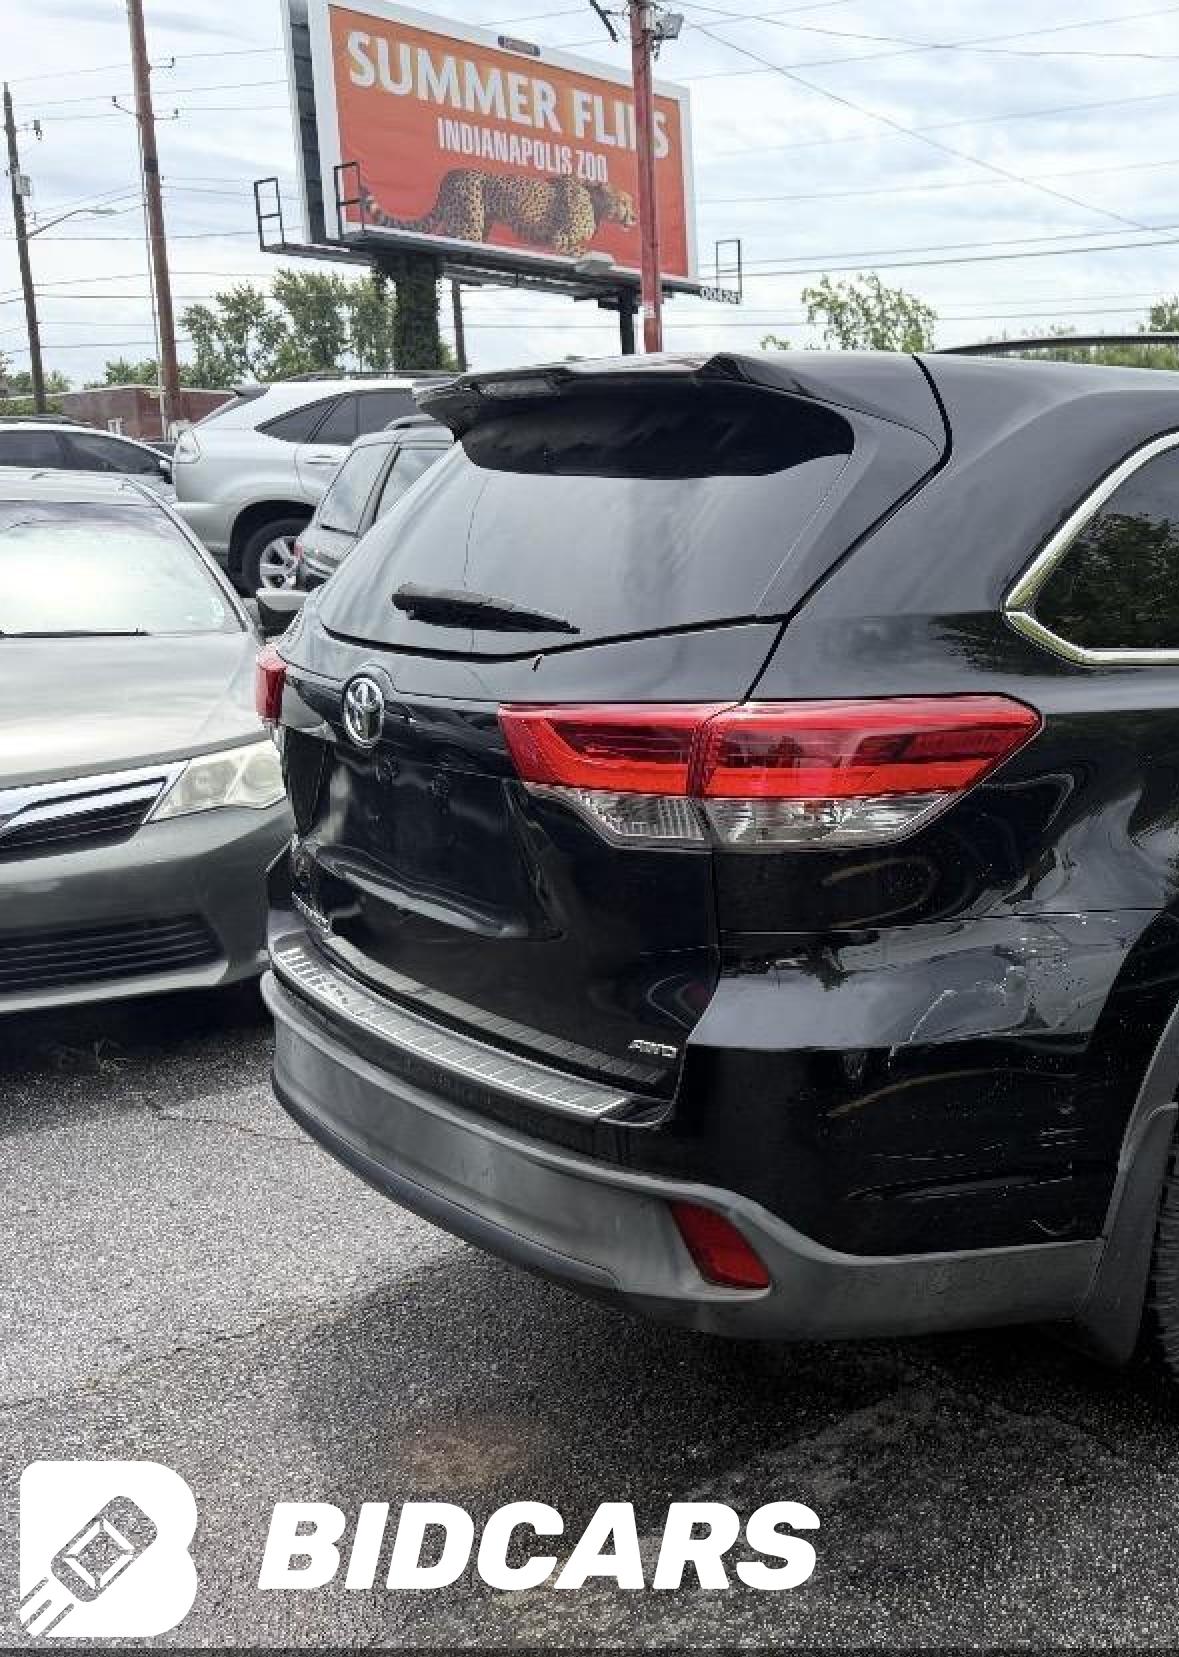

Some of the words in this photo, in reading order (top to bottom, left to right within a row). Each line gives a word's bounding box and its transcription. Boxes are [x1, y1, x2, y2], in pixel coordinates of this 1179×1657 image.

[348, 32, 561, 133] SUMMER
[437, 117, 572, 174] INDIANAPOLIS
[574, 149, 608, 183] ZOO
[628, 1039, 678, 1058] AWD
